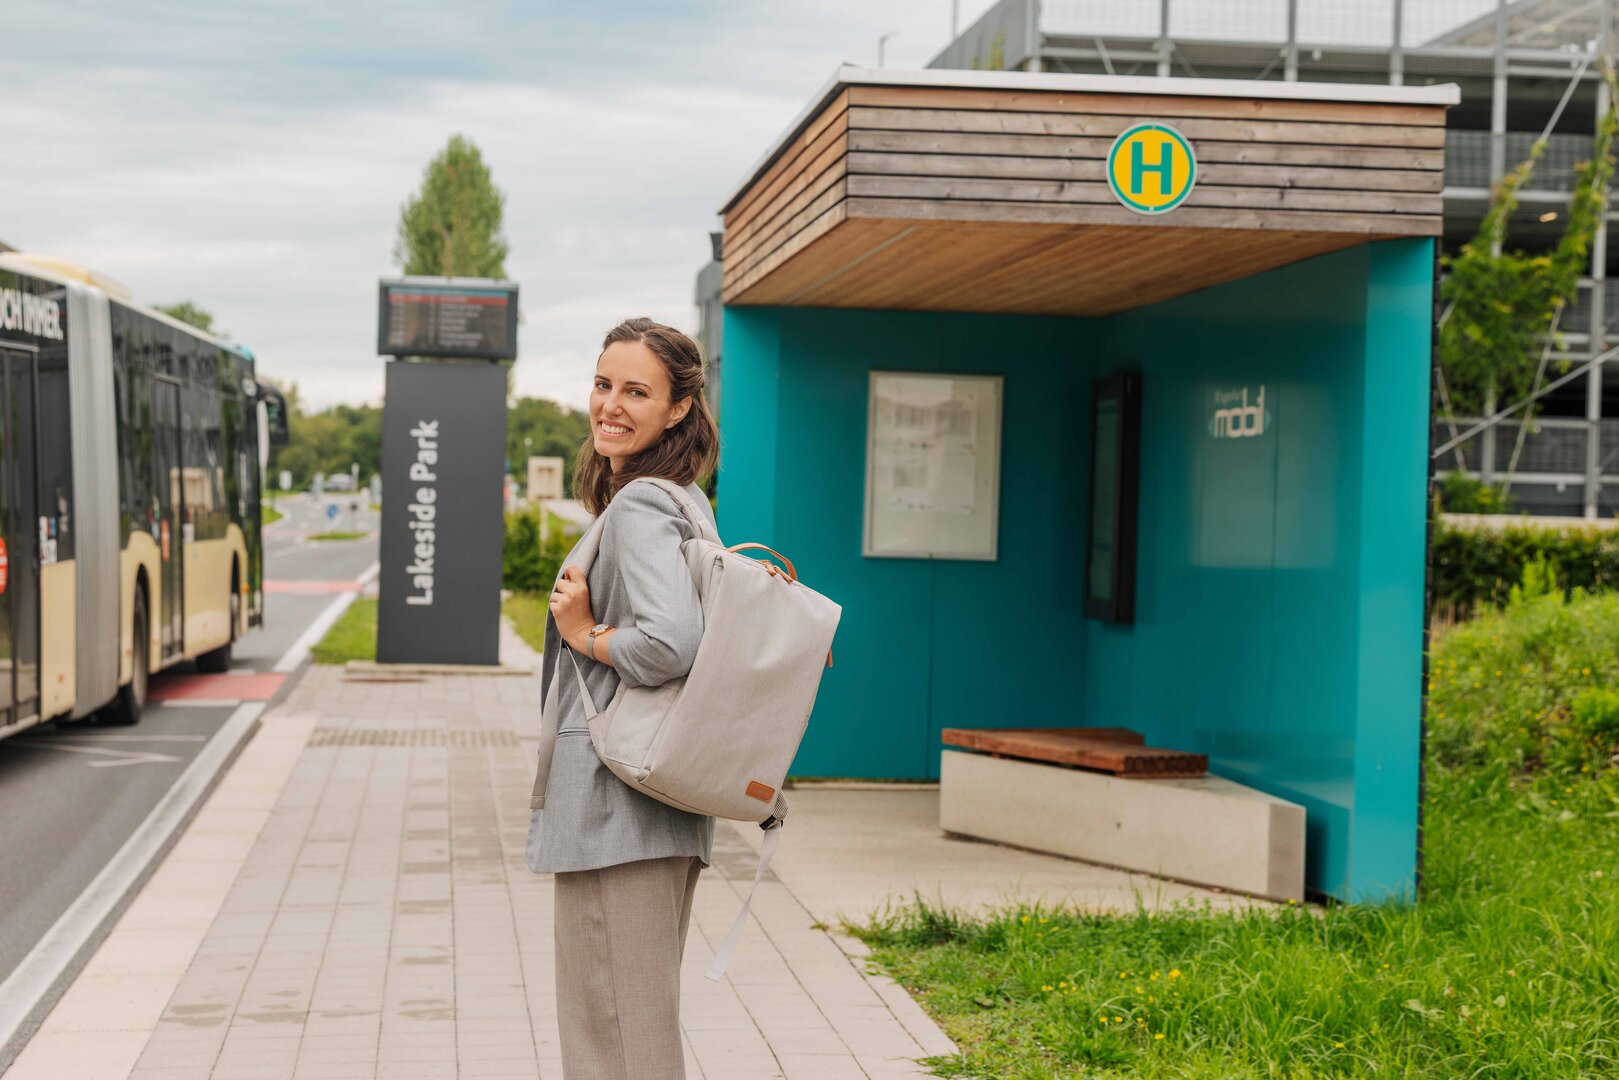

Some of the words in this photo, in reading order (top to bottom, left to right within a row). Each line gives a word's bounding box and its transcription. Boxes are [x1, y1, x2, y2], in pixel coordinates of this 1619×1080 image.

[1131, 141, 1172, 195] H
[409, 420, 439, 481] Park
[405, 487, 437, 605] Lakeside
